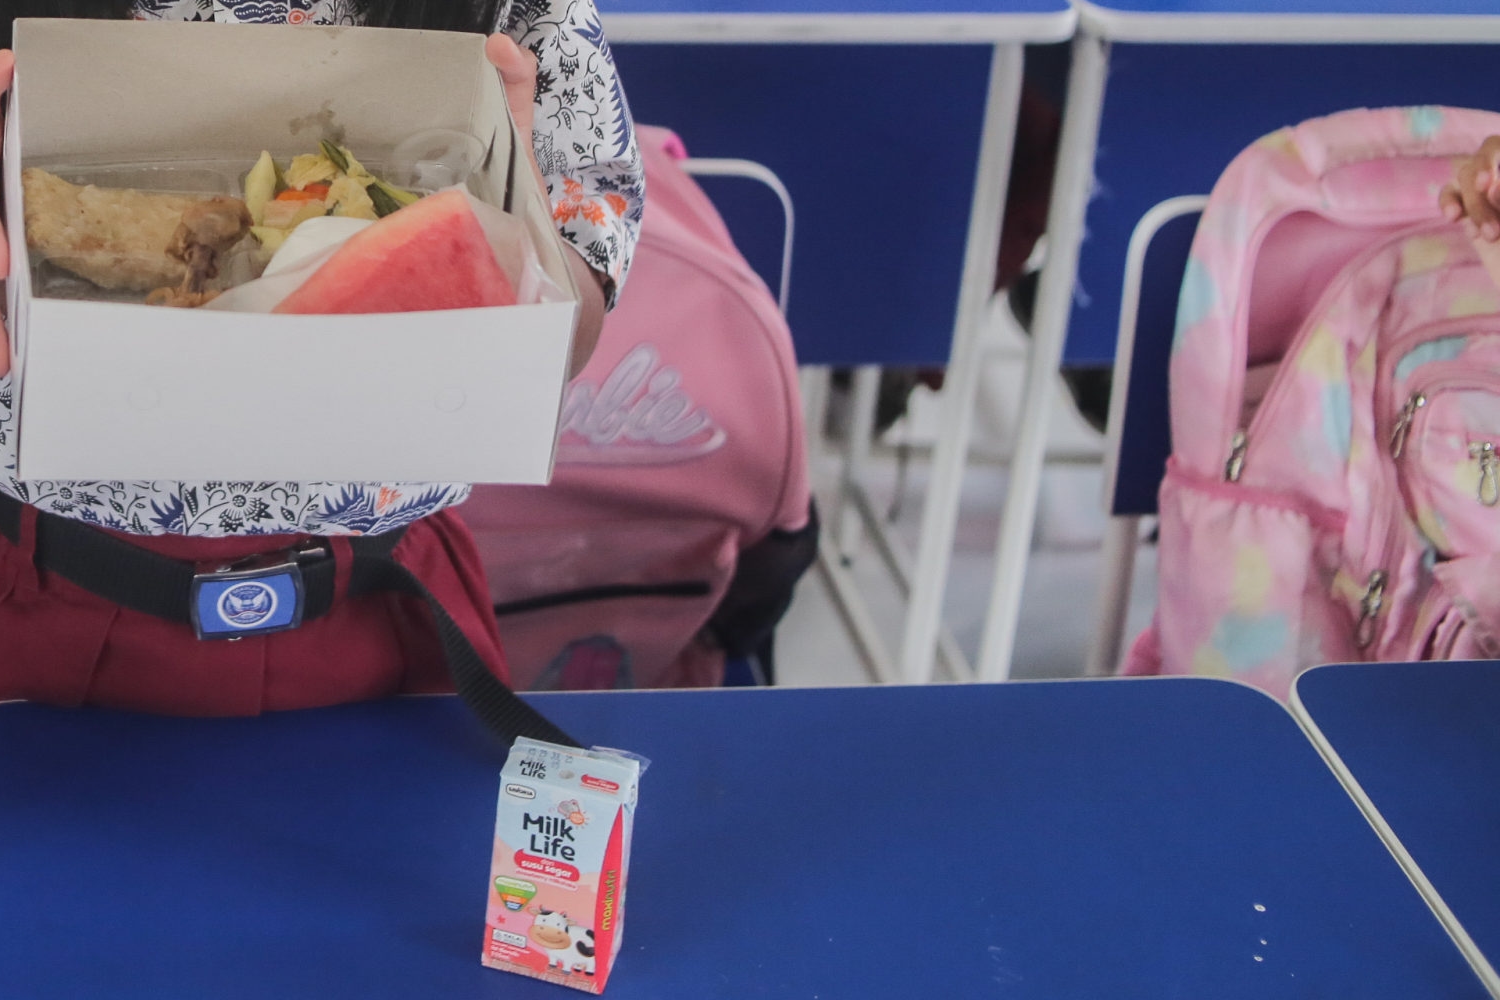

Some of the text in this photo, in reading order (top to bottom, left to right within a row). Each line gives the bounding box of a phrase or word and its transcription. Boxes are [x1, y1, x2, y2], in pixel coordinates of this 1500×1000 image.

[561, 340, 713, 445] rbie
[520, 759, 546, 772] Milk
[521, 767, 546, 780] Life
[522, 812, 575, 842] Milk
[530, 834, 576, 861] Life
[521, 860, 573, 878] susu segar
